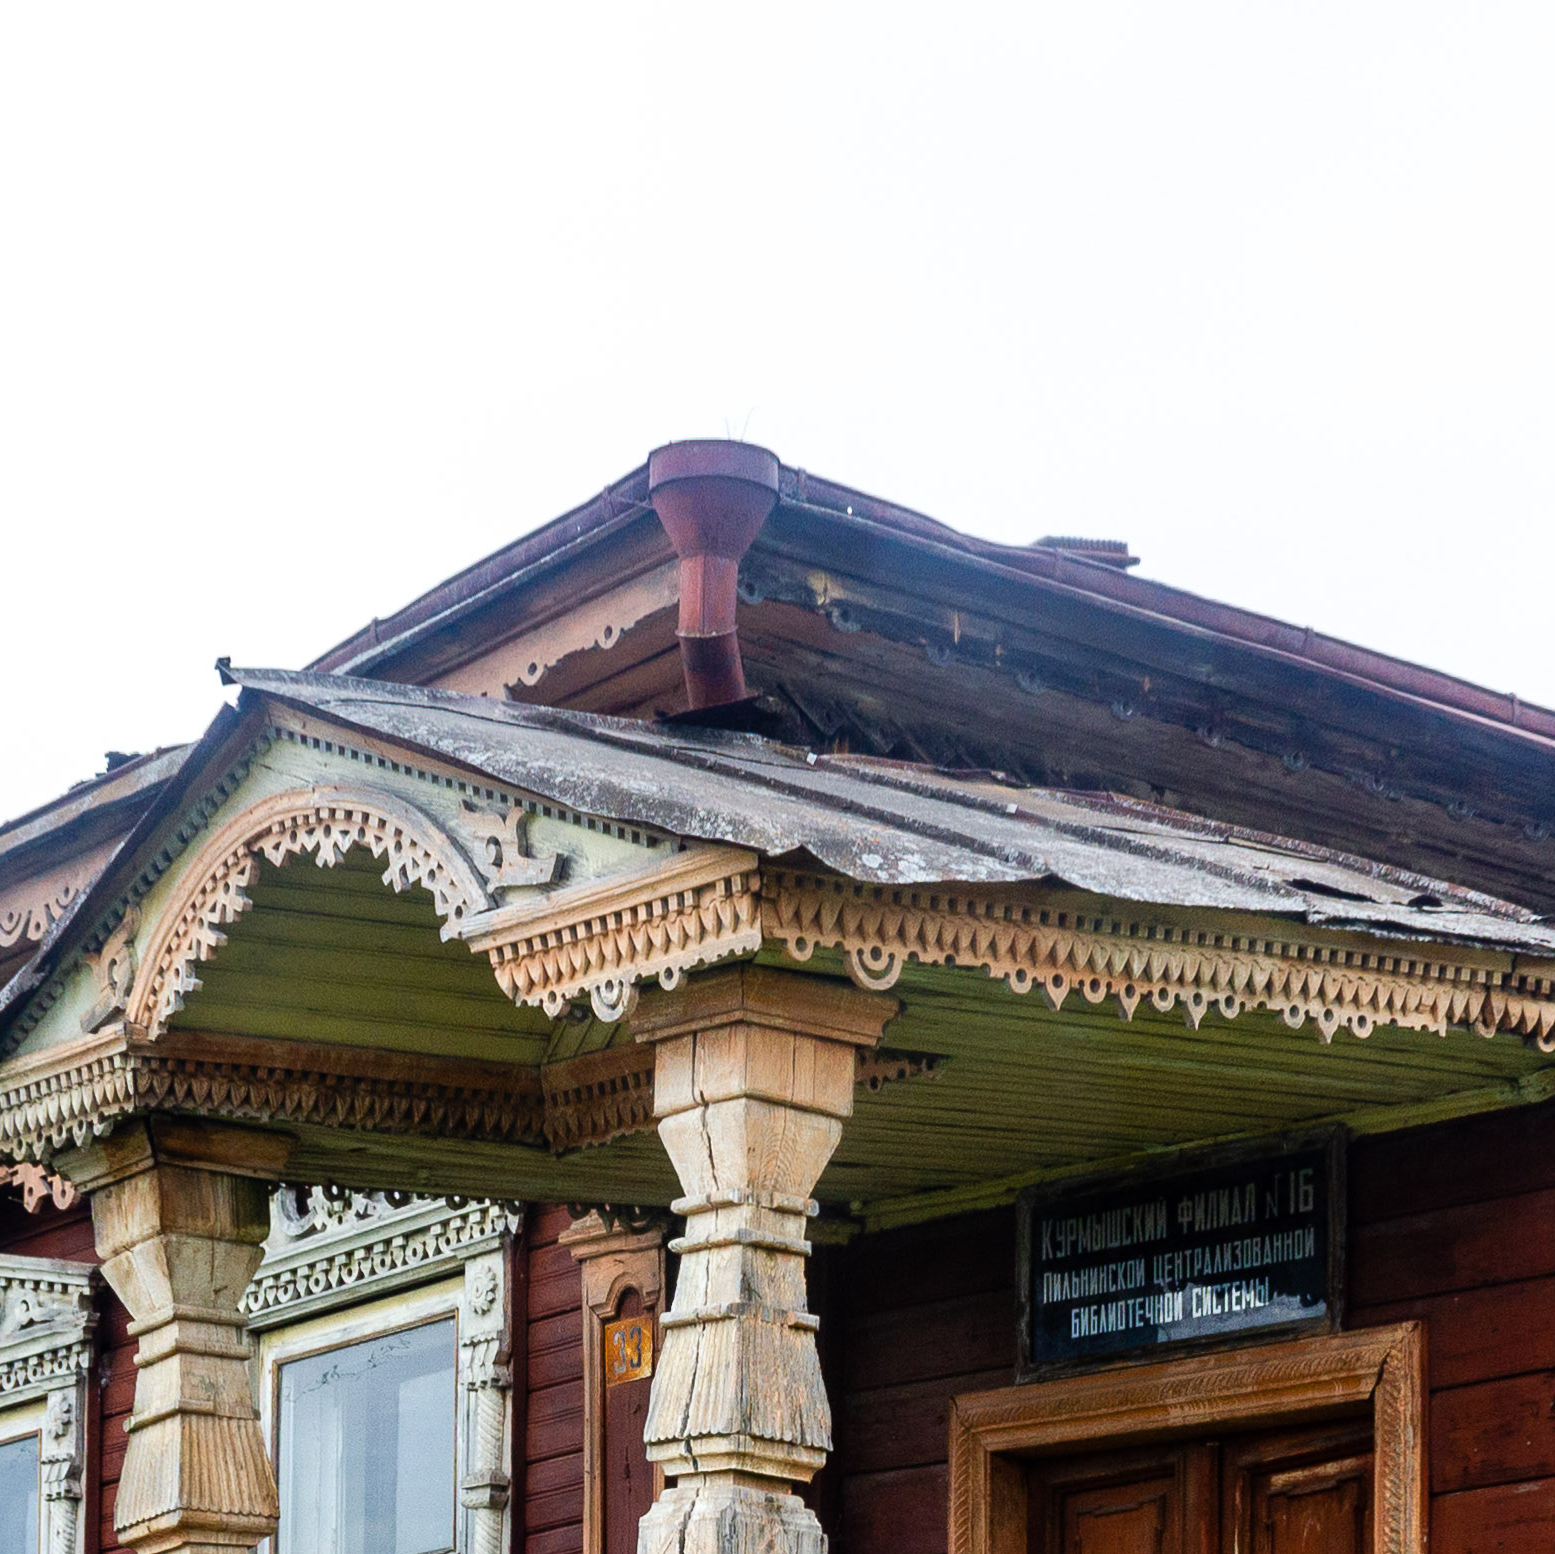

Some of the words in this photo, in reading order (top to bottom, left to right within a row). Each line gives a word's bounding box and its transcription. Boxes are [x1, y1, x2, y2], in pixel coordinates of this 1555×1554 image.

[1041, 1196, 1167, 1260] КУРМЫШСКИЙ
[1177, 1182, 1256, 1234] ФИЛИАЛ
[1289, 1168, 1315, 1215] 16
[1043, 1256, 1146, 1303] ПИЛЬНИНСКОЙ
[1152, 1224, 1315, 1286] ЦЕНТРАЛИЗОВАННОЙ
[1070, 1288, 1184, 1339] БИБЛИОТЕЧНОЙ
[1191, 1276, 1270, 1319] СИСТЕМЫ
[614, 1327, 641, 1373] 33
